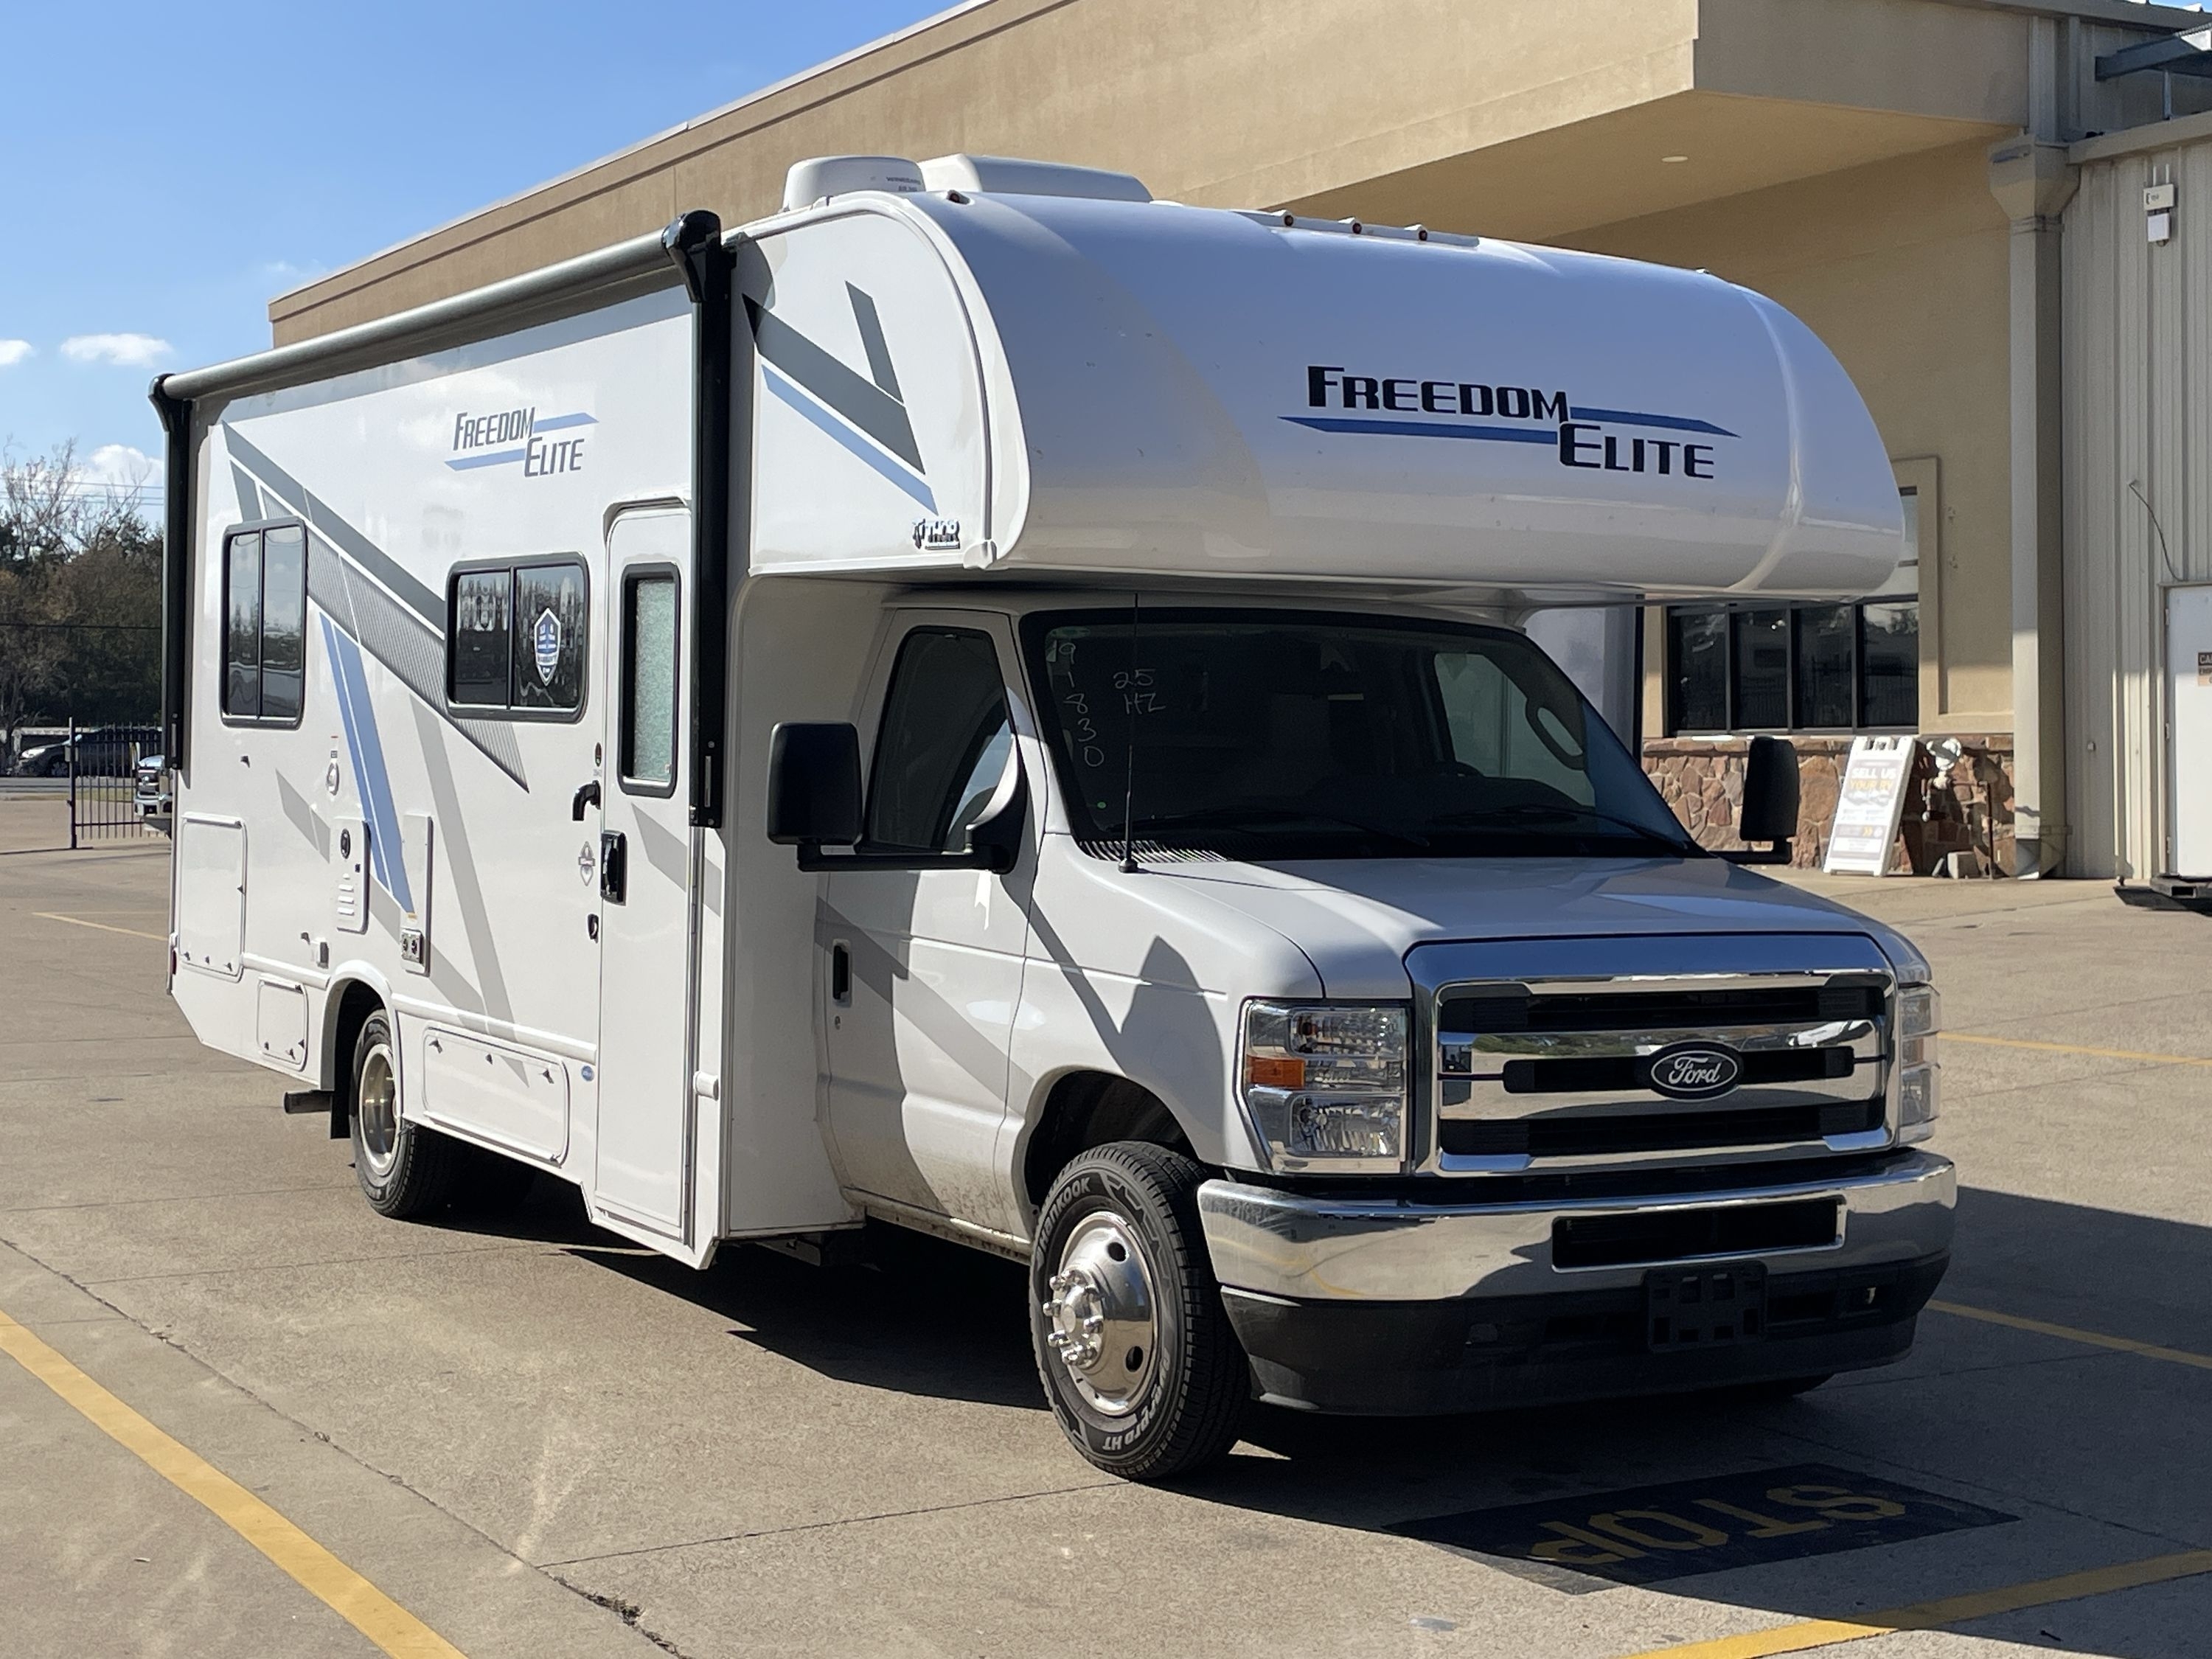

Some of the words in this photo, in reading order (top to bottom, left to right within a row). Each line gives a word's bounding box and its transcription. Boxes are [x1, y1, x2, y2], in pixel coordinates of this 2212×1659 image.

[1307, 365, 1568, 422] FREEDOM
[453, 406, 535, 451] FREEDOM
[1559, 422, 1714, 479] ELITE
[524, 437, 585, 478] ELITE
[1851, 768, 1878, 779] SELL
[1668, 1057, 1722, 1084] Ford
[1527, 1484, 1906, 1565] STOP
